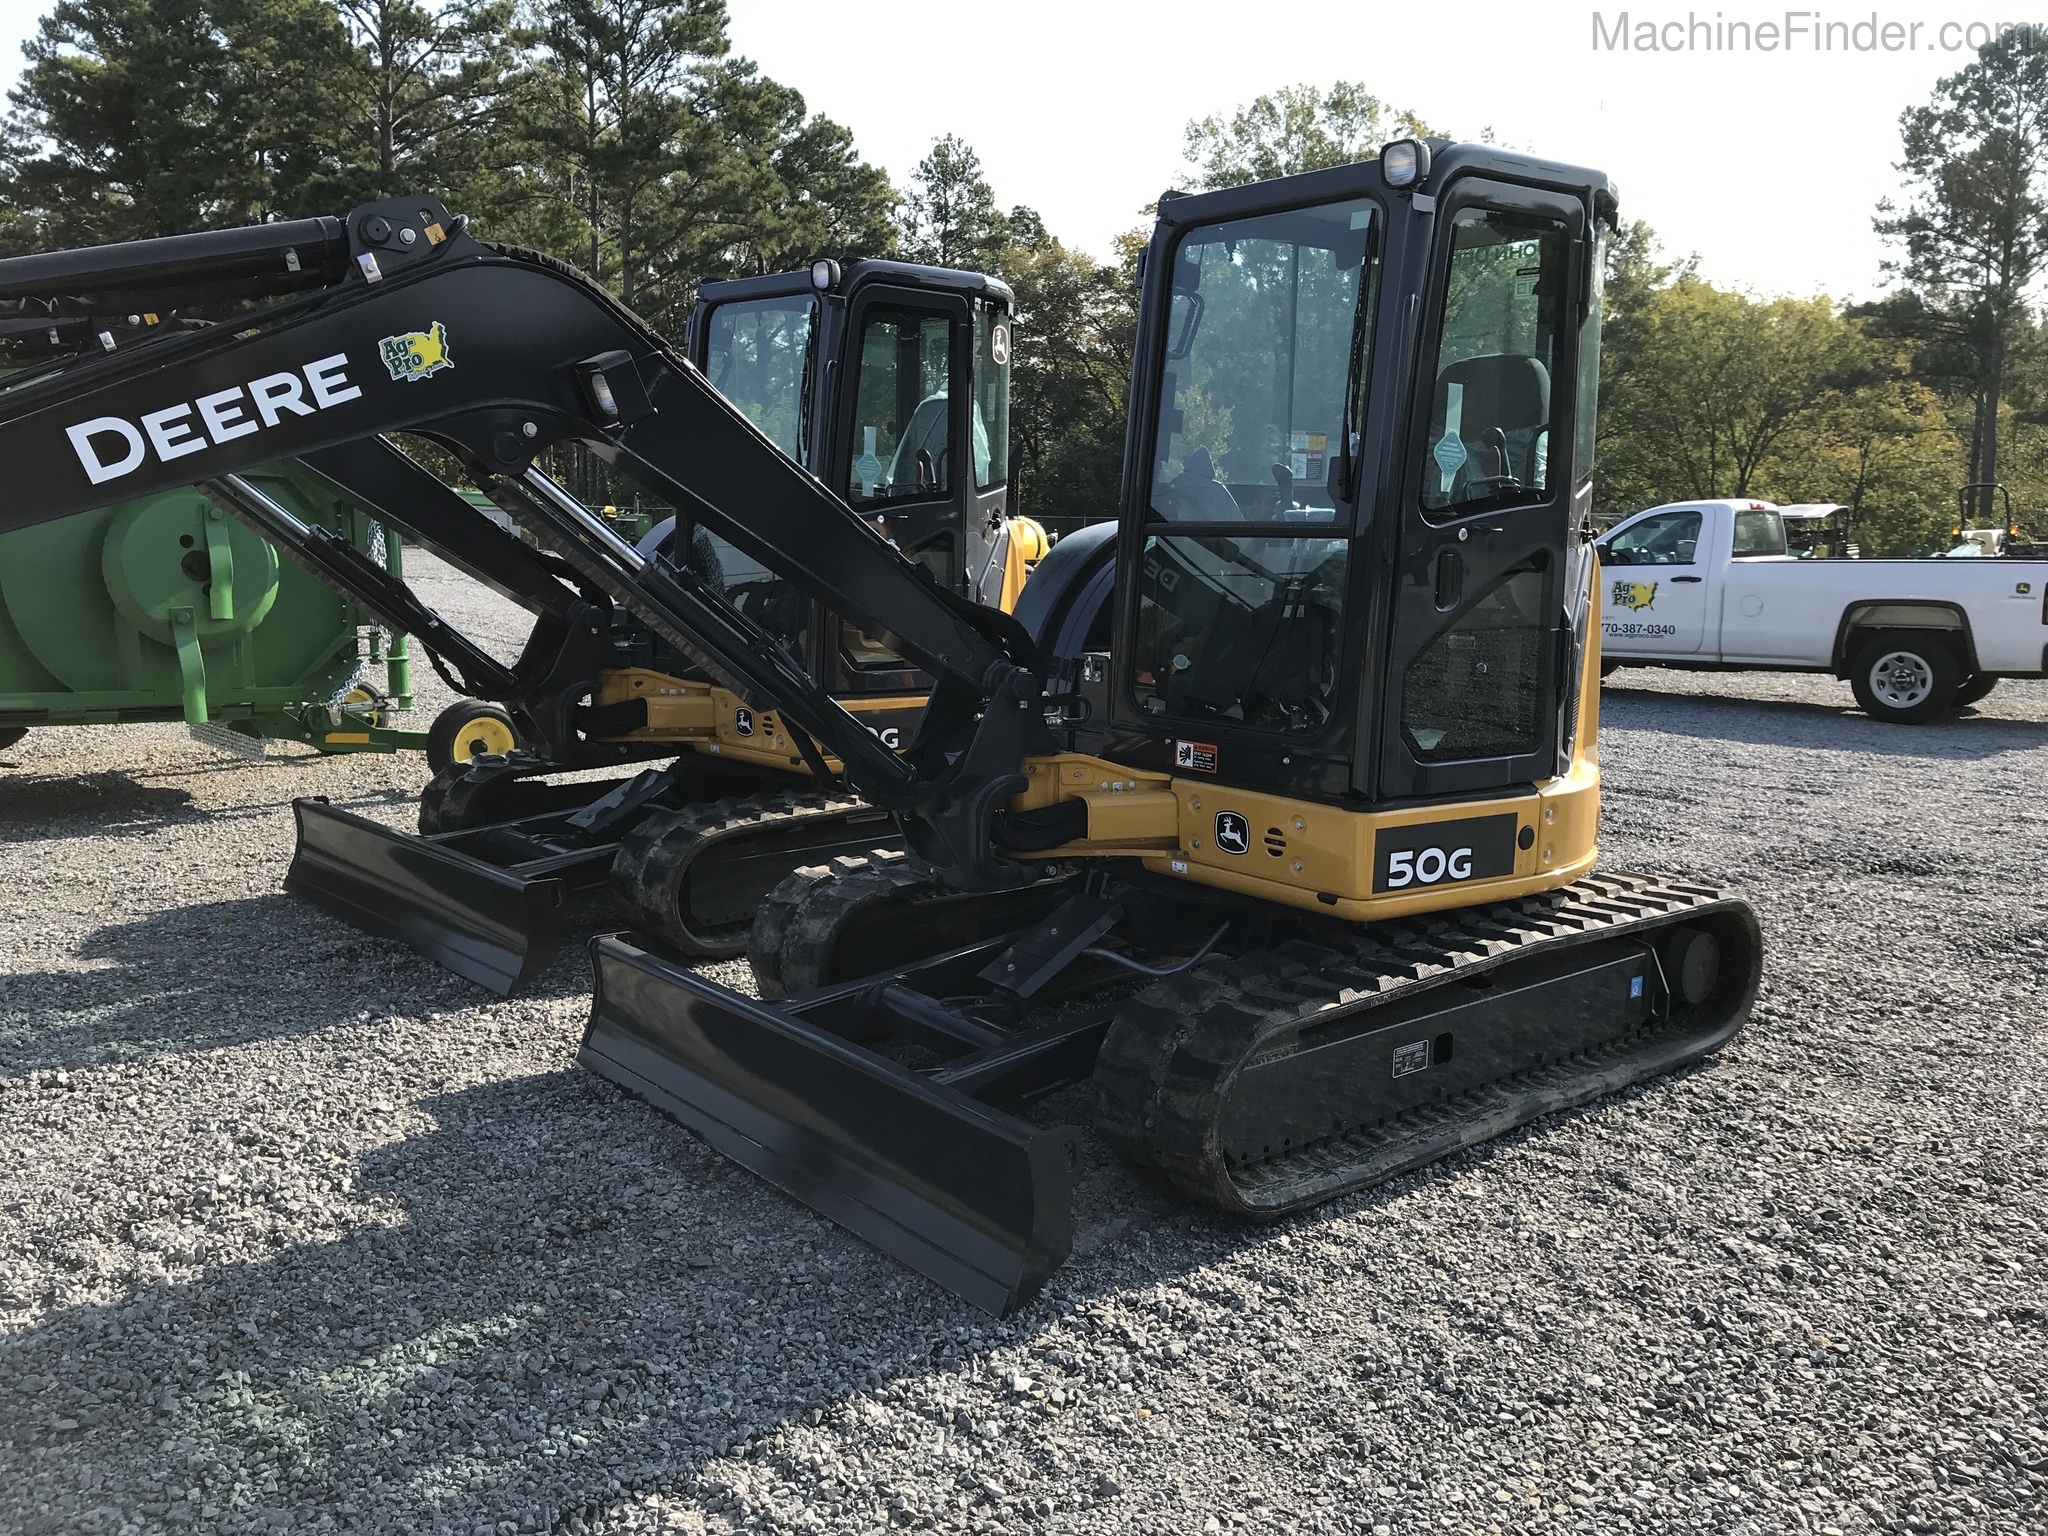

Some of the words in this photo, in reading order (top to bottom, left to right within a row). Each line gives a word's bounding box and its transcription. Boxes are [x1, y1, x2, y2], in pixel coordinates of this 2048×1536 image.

[384, 339, 414, 360] Ag-
[389, 354, 422, 376] Pro
[65, 353, 362, 485] DEERE
[1612, 581, 1636, 595] Ag-
[1613, 593, 1636, 605] Pro
[1388, 848, 1472, 887] 50G
